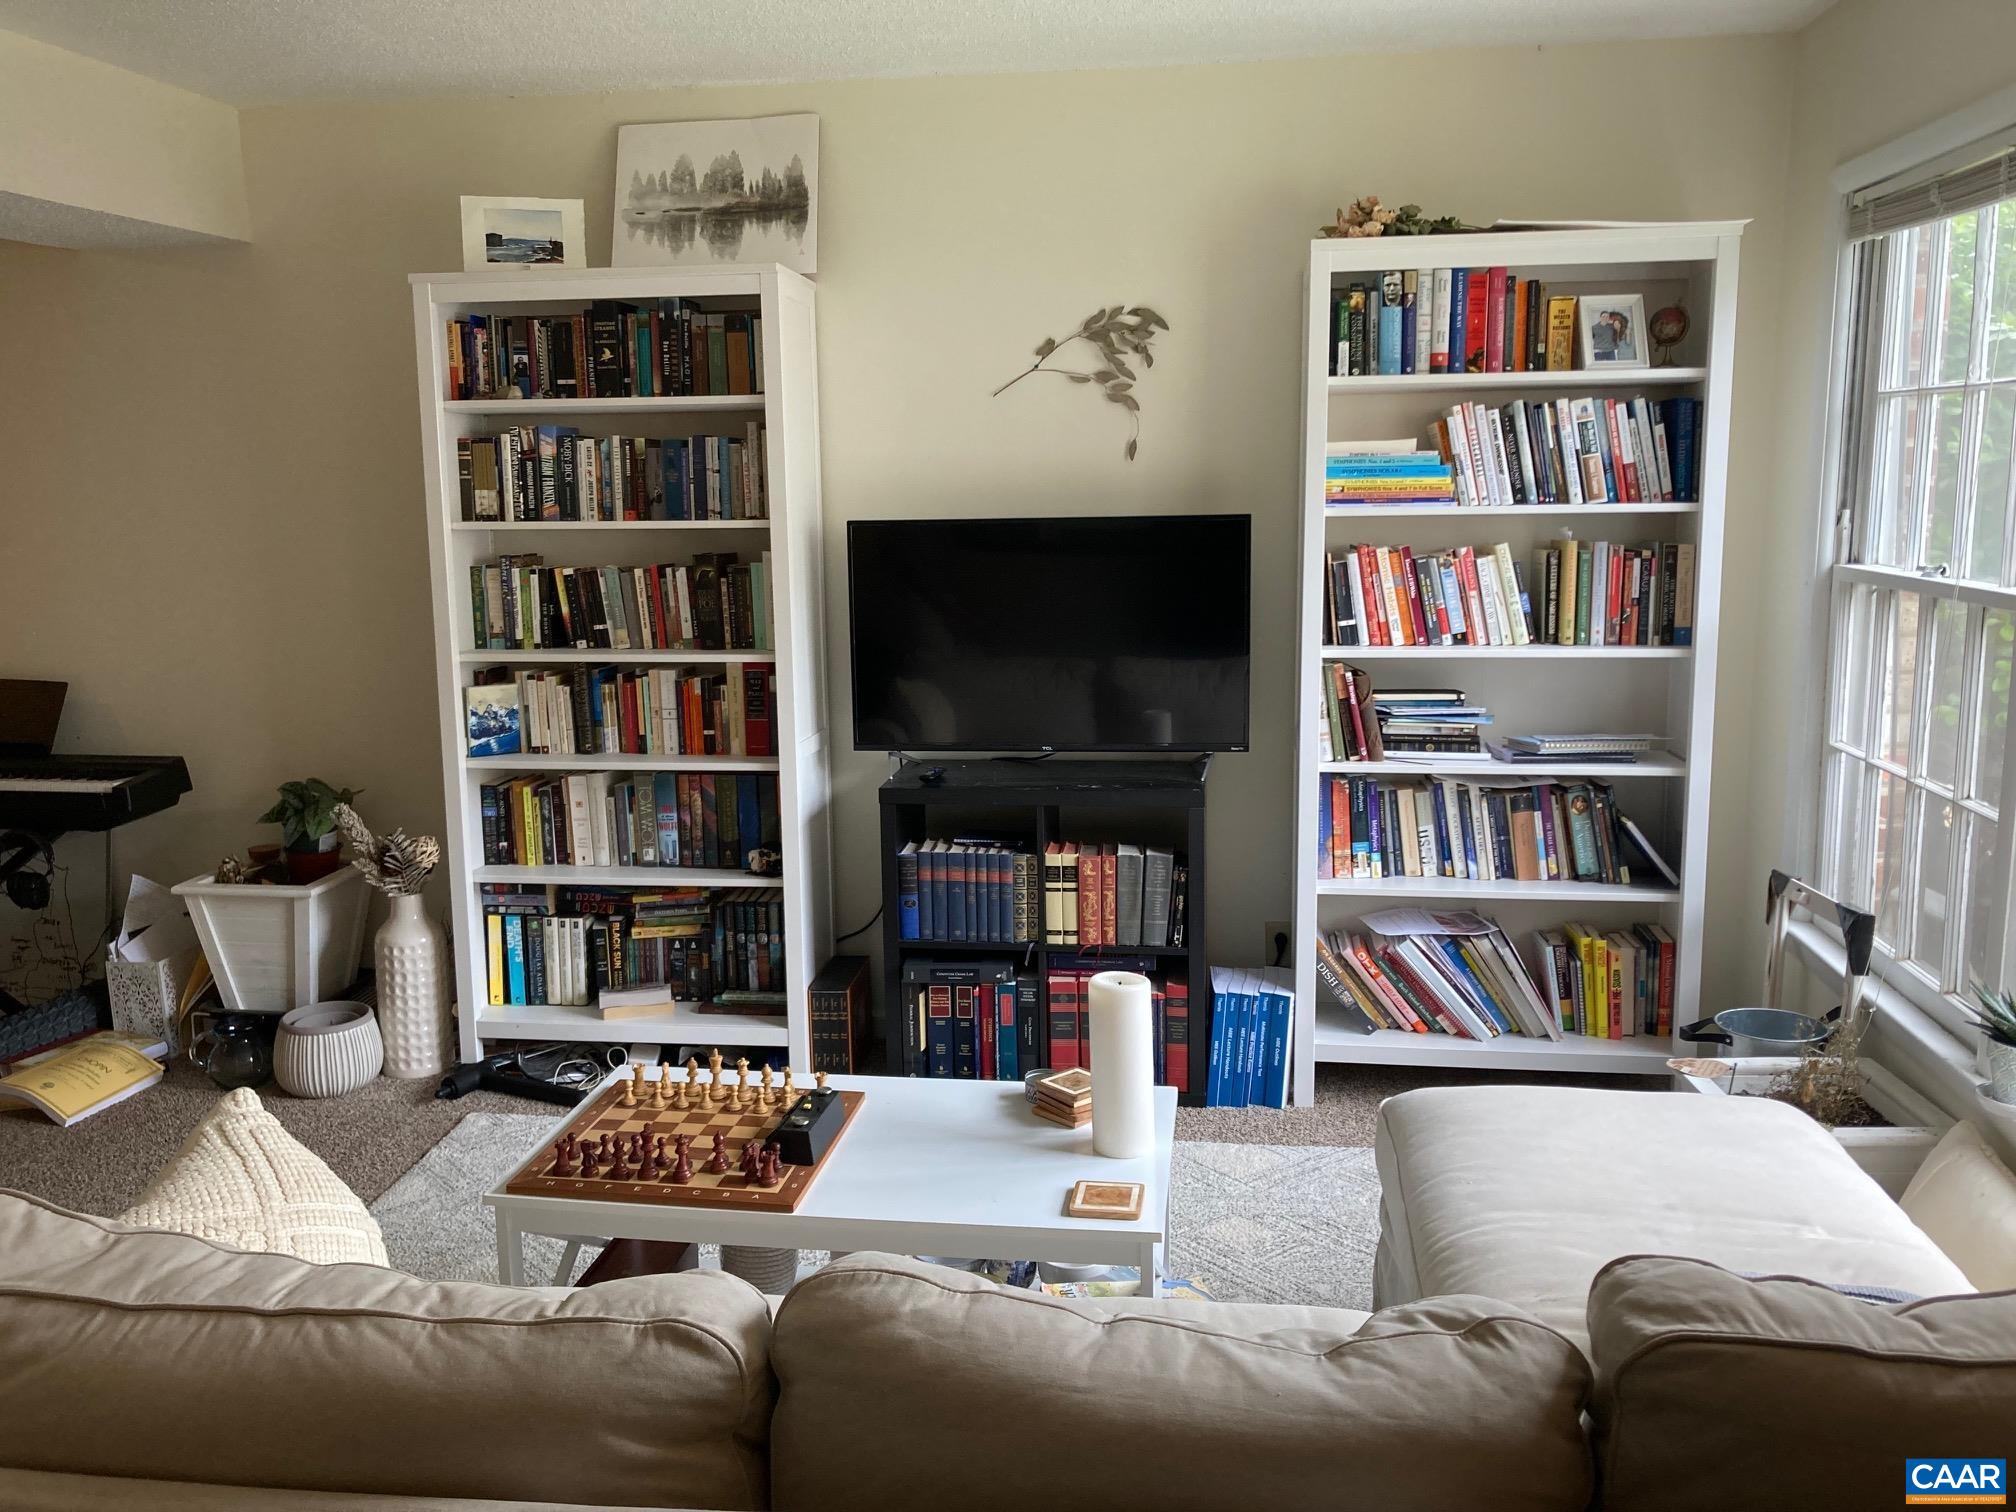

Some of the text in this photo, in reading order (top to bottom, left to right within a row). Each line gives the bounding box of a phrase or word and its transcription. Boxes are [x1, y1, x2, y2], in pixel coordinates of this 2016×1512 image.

[1378, 550, 1402, 617] Atomic Habits
[1642, 562, 1650, 592] ICARUS
[639, 784, 652, 815] TOM
[1371, 820, 1379, 852] Metaphysics
[1577, 832, 1586, 864] America
[506, 924, 514, 950] END
[513, 920, 524, 963] DEATH'S
[612, 922, 621, 951] BLACK
[534, 936, 545, 998] DOUGLAS ADAMS
[614, 952, 623, 970] SUN
[1317, 962, 1338, 987] DISH
[1224, 1057, 1232, 1078] Handouts
